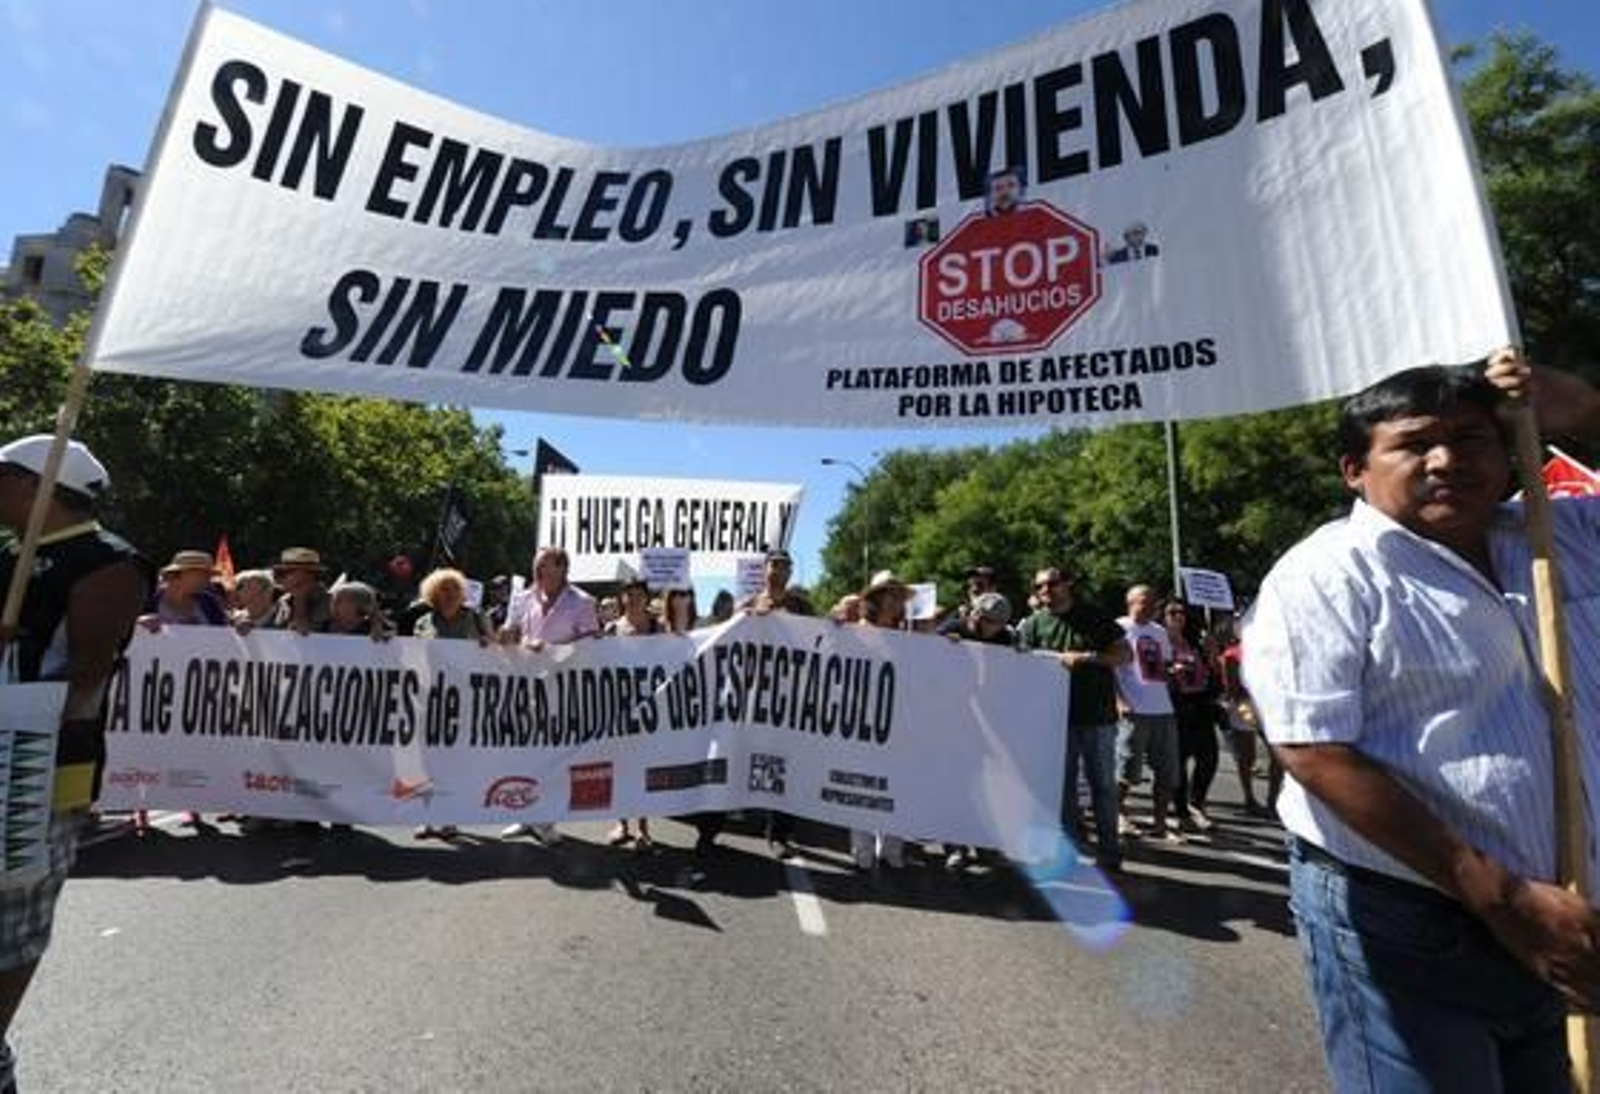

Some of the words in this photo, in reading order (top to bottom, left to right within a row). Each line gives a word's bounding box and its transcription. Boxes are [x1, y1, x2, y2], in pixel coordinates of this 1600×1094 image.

[194, 60, 364, 201] SIN
[366, 122, 693, 250] EMPLEO,
[708, 136, 842, 239] SIN
[866, 0, 1396, 217] VIVIENDA,
[937, 234, 1079, 296] STOP
[300, 269, 470, 368] SIN
[462, 286, 742, 386] MIEDO
[936, 284, 1083, 322] DESAHUCIOS
[825, 361, 993, 390] PLATAFORMA
[999, 356, 1034, 384] DE
[1037, 338, 1218, 382] AFECTADOS
[897, 393, 950, 418] POR
[957, 392, 992, 417] LA
[1000, 383, 1143, 417] HIPOTECA
[575, 497, 664, 555] HUELGA
[673, 498, 770, 554] GENERAL
[140, 657, 174, 735] de
[181, 657, 419, 746] ORGANIZACIONES
[425, 671, 461, 747] de
[469, 663, 666, 748] TRABAJADORES
[712, 636, 896, 745] ESPECTÁCULO
